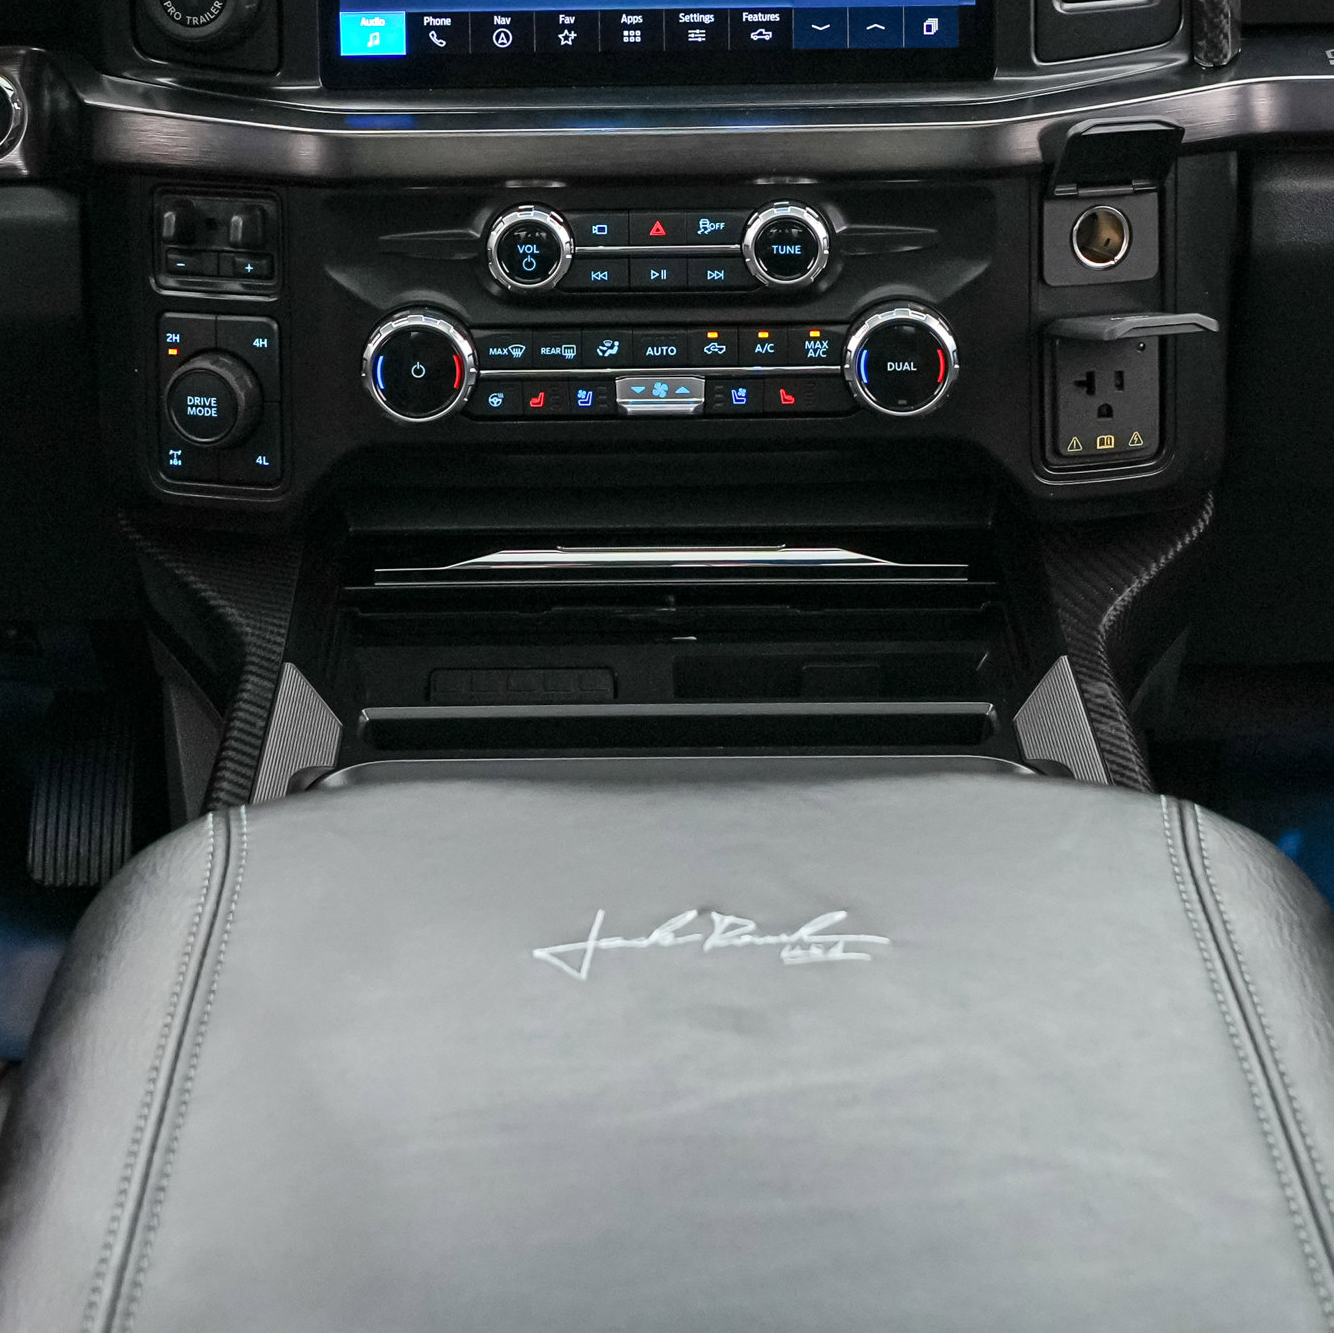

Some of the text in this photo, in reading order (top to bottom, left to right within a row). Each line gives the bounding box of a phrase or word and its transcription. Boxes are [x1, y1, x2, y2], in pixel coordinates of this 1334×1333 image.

[163, 0, 223, 26] PRO TRAILER
[679, 12, 715, 23] Settings
[742, 12, 780, 22] Features
[360, 17, 385, 27] Audio
[423, 16, 451, 26] Phone
[493, 15, 511, 25] Nav
[559, 15, 575, 25] Fav
[621, 14, 643, 25] Apps
[709, 222, 725, 231] OFF
[517, 244, 539, 254] VOL
[772, 245, 802, 255] TUNE
[166, 333, 180, 343] 2H
[253, 338, 268, 348] 4H
[755, 343, 775, 354] A/C
[805, 341, 829, 349] MAX
[489, 347, 508, 356] MAX
[541, 347, 561, 355] REAR
[647, 346, 677, 356] AUTO
[807, 348, 827, 358] A/C
[887, 362, 917, 371] DUAL
[187, 397, 217, 407] DRIVE
[187, 406, 218, 417] MODE
[256, 456, 269, 466] 4L
